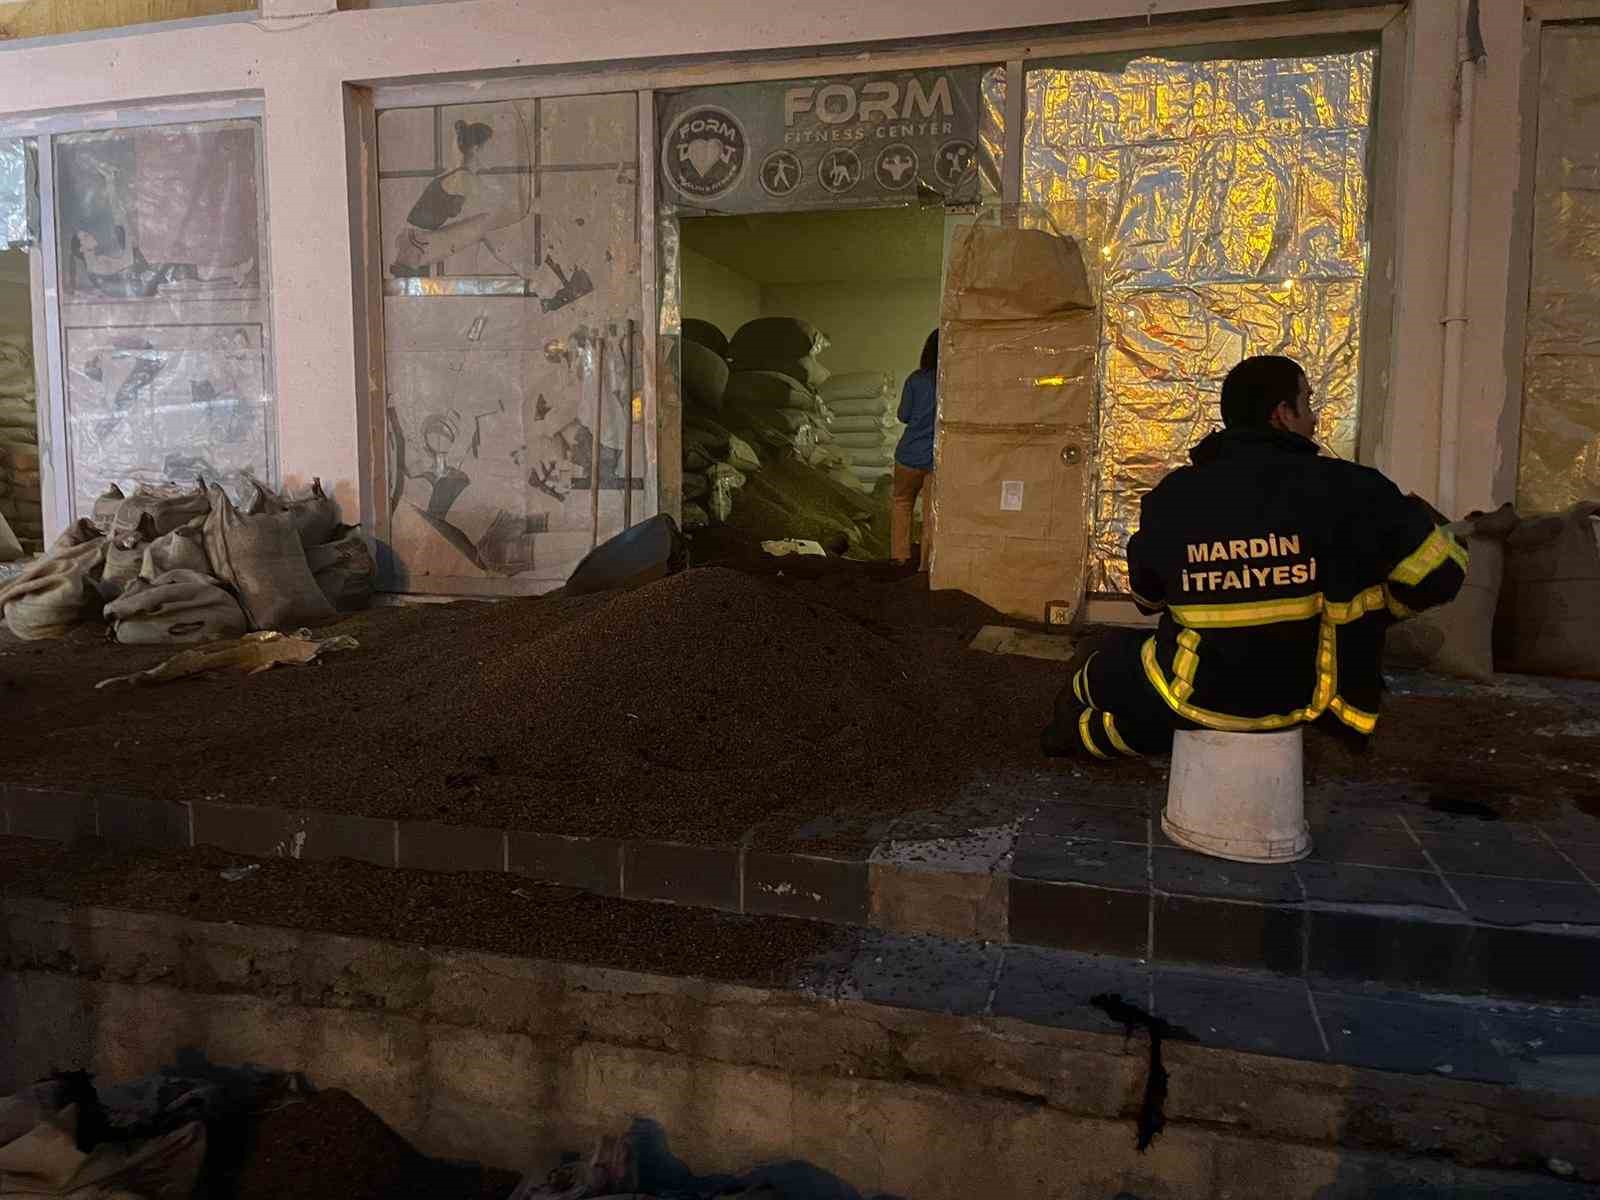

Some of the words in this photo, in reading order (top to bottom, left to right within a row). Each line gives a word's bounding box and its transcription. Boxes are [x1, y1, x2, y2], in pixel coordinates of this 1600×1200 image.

[785, 78, 953, 126] FORM
[679, 120, 736, 141] FORM
[785, 128, 865, 143] FITNESS
[877, 123, 953, 138] CENTER
[1187, 533, 1300, 563] MARDİN
[1182, 558, 1316, 592] İTFAİYESİ
